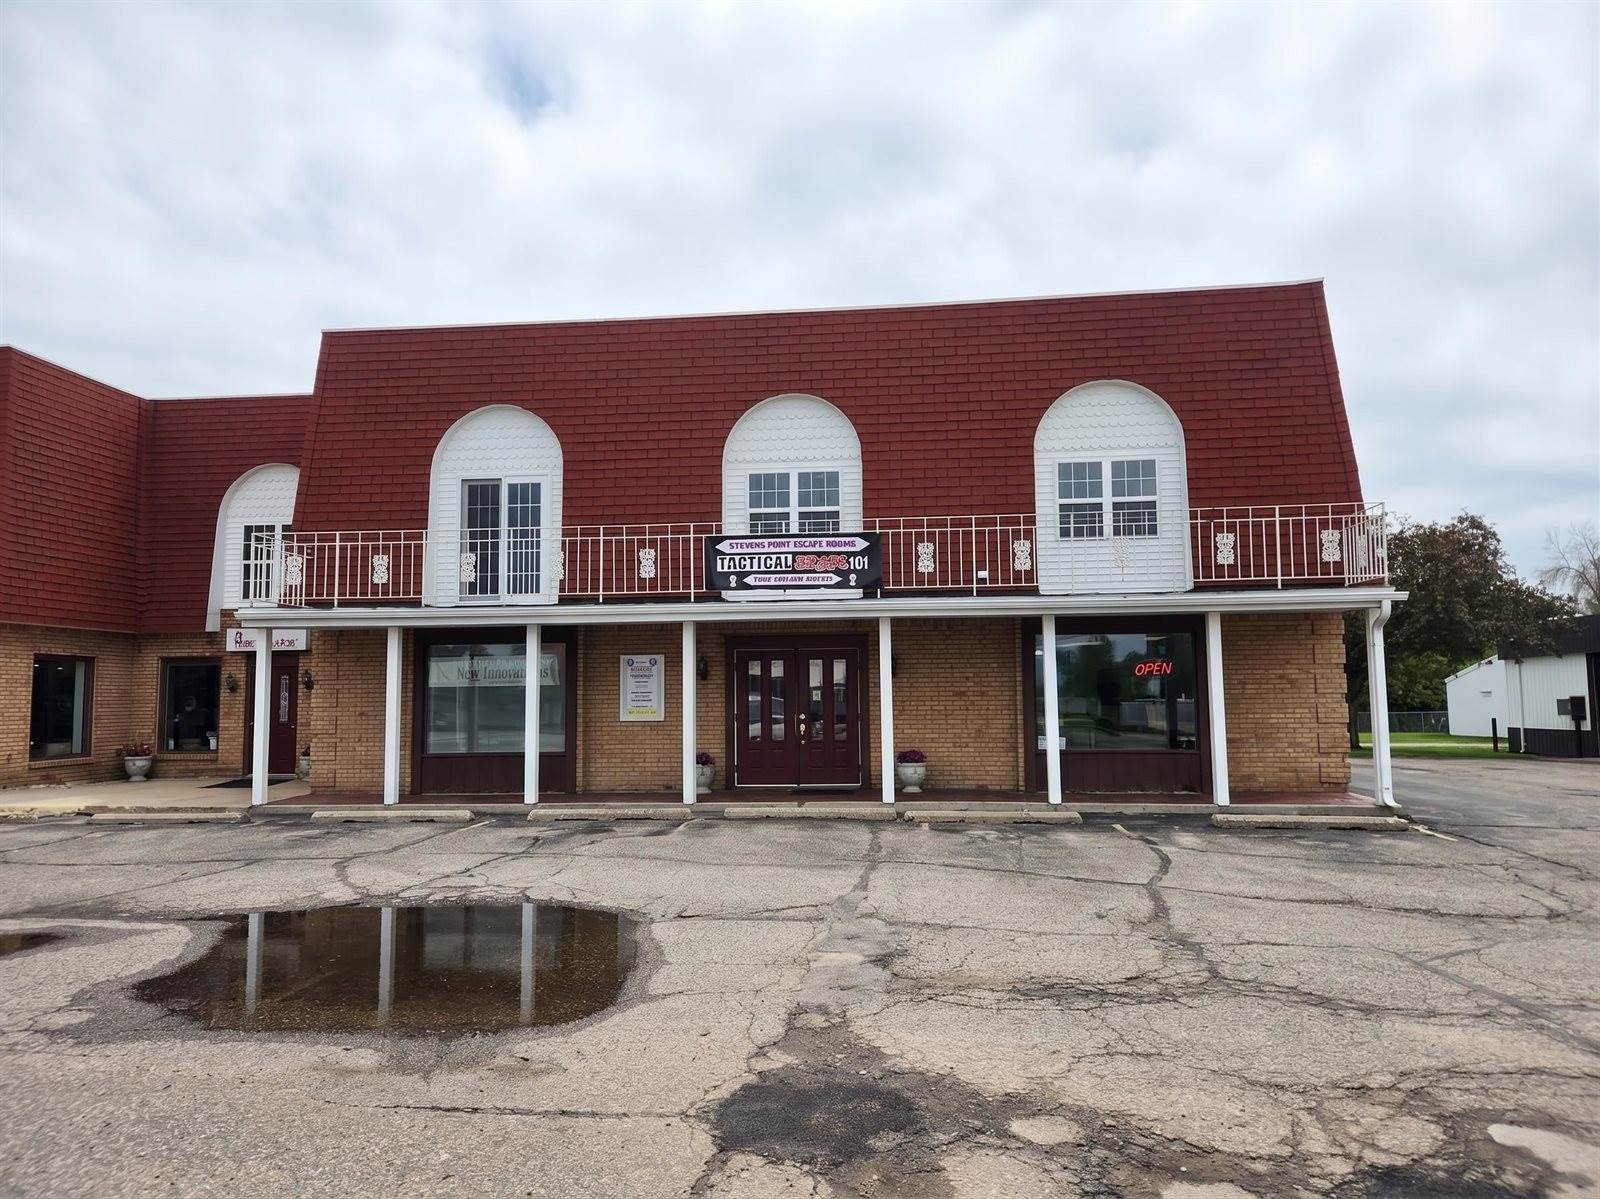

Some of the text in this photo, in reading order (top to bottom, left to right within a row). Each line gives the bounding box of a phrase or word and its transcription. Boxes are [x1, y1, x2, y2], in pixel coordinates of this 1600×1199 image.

[729, 539, 857, 550] STEVENS POINT ESCAPE ROOMS
[718, 555, 792, 570] TACTICAL
[849, 555, 869, 570] 101
[457, 667, 480, 680] New
[1135, 662, 1173, 676] OPEN
